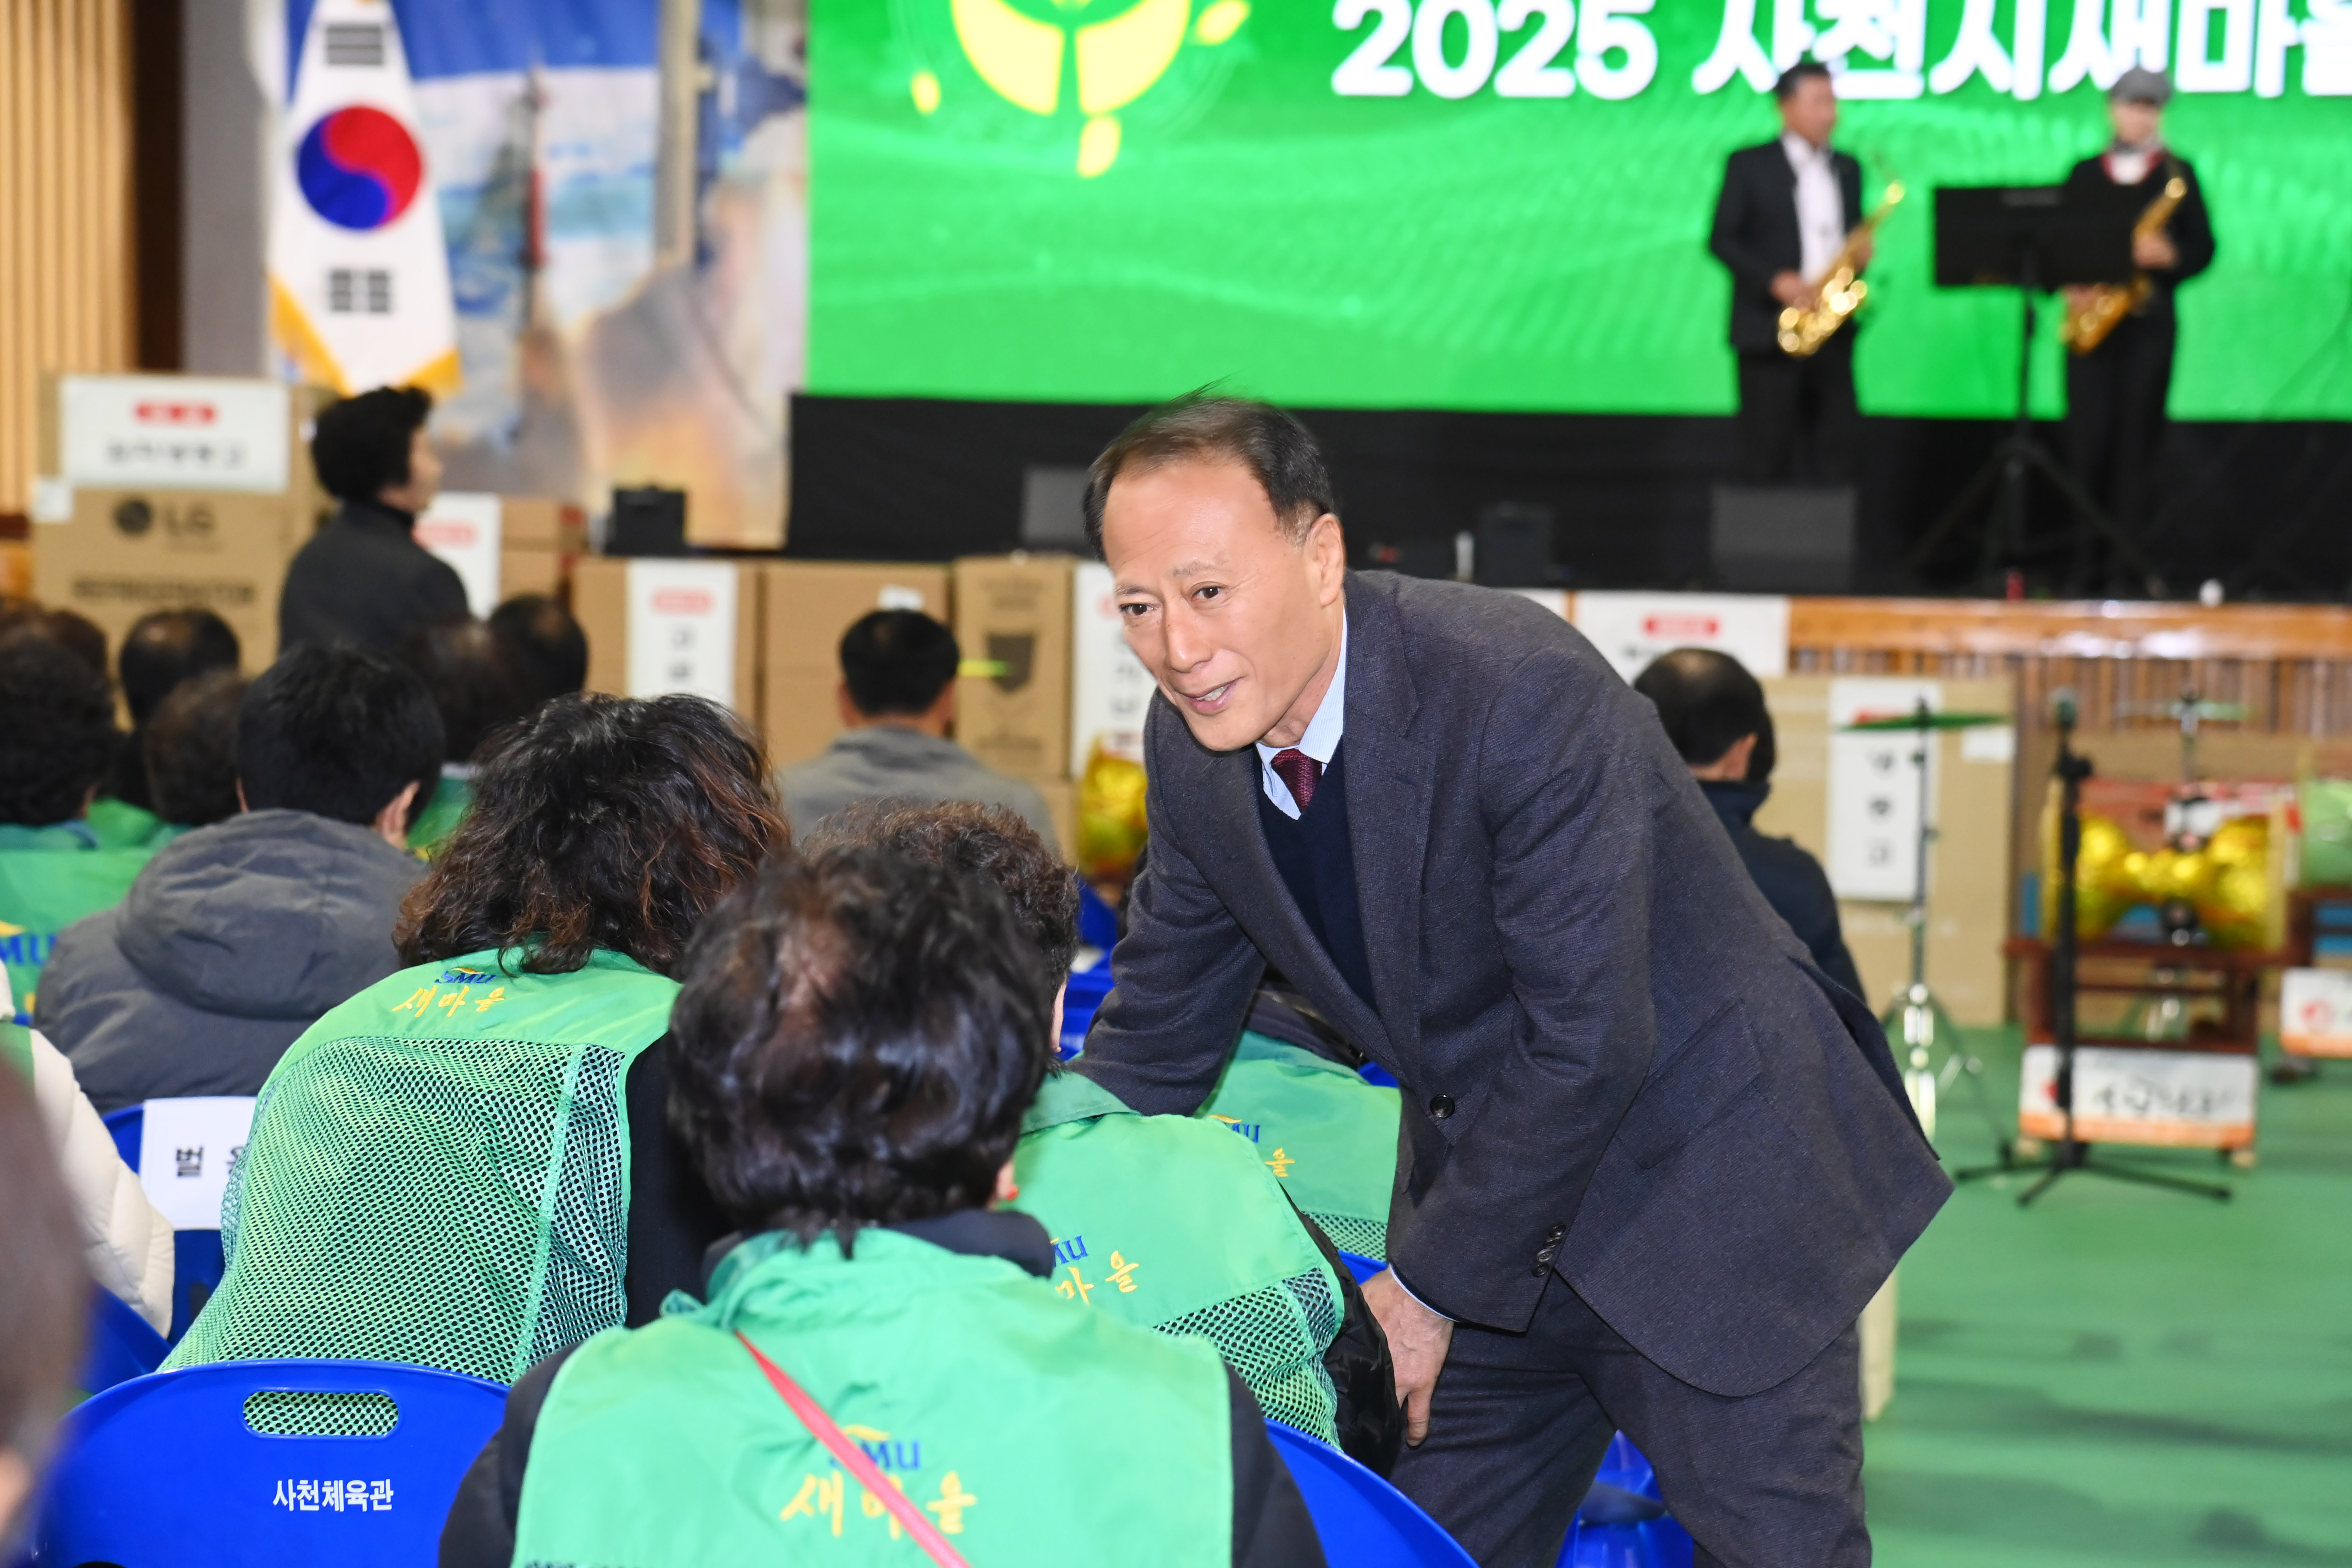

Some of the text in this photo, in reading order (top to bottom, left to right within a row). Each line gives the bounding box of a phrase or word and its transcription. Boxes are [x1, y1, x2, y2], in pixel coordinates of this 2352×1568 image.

[1331, 0, 1658, 100] 2025
[435, 971, 497, 983] SMU
[392, 985, 505, 1017] 새마을
[1055, 1250, 1139, 1305] 마을
[830, 1440, 920, 1470] MU
[273, 1478, 393, 1512] 사천체육관
